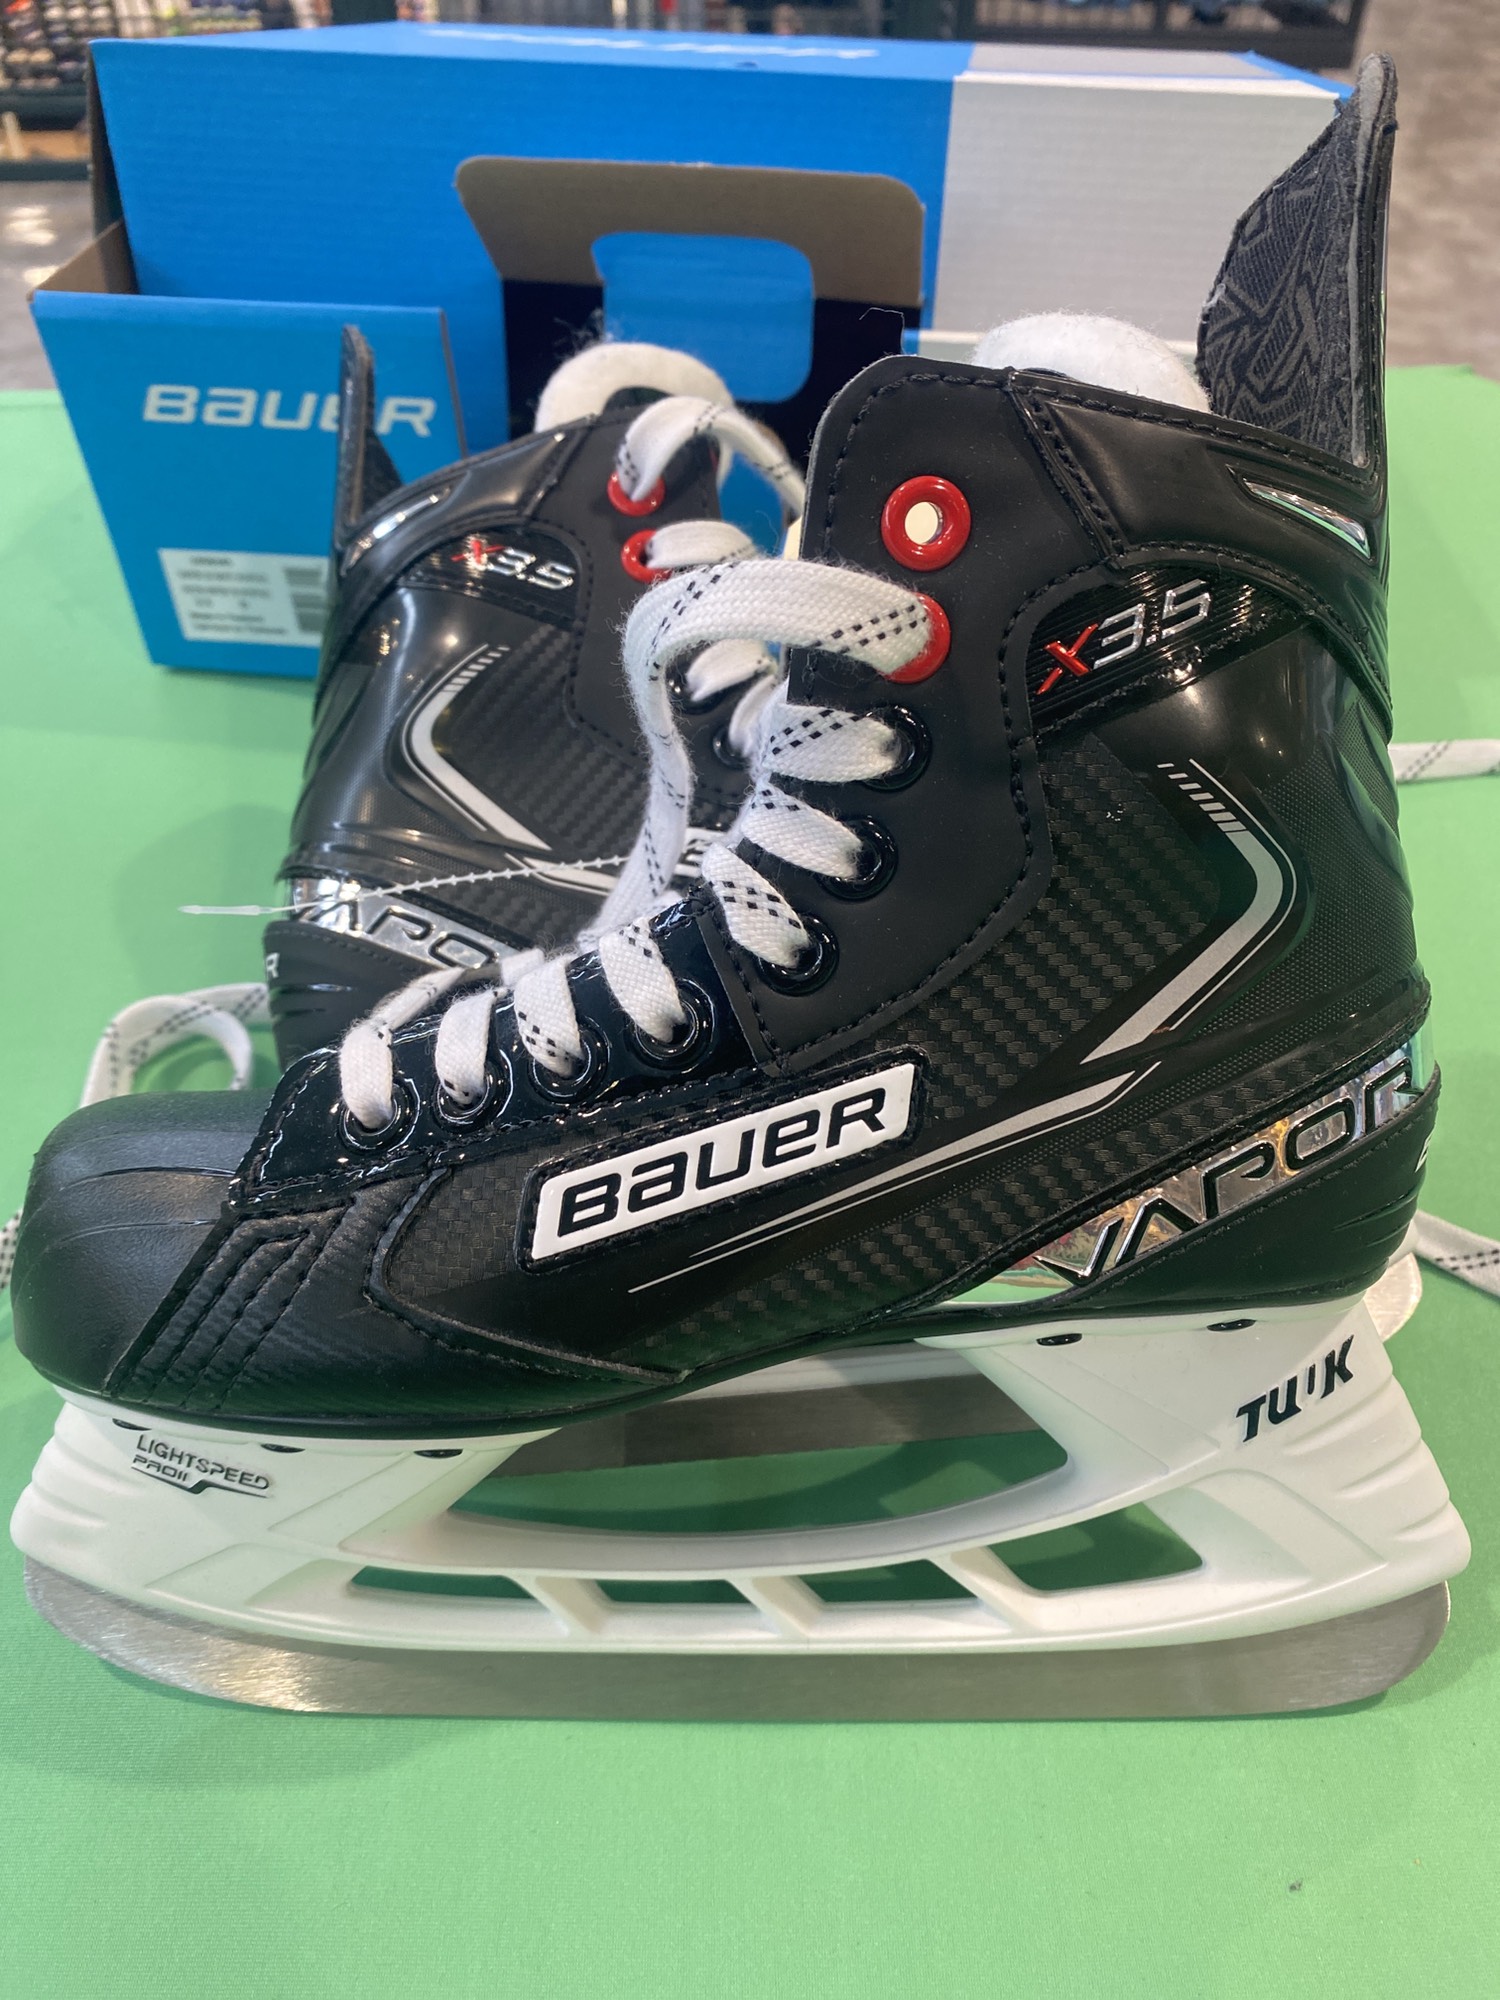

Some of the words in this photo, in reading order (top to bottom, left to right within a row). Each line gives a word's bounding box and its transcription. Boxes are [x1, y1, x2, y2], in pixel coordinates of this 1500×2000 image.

[450, 539, 576, 590] X3.5
[1036, 579, 1211, 696] X3.5
[136, 1434, 270, 1490] LIGHTSPEED
